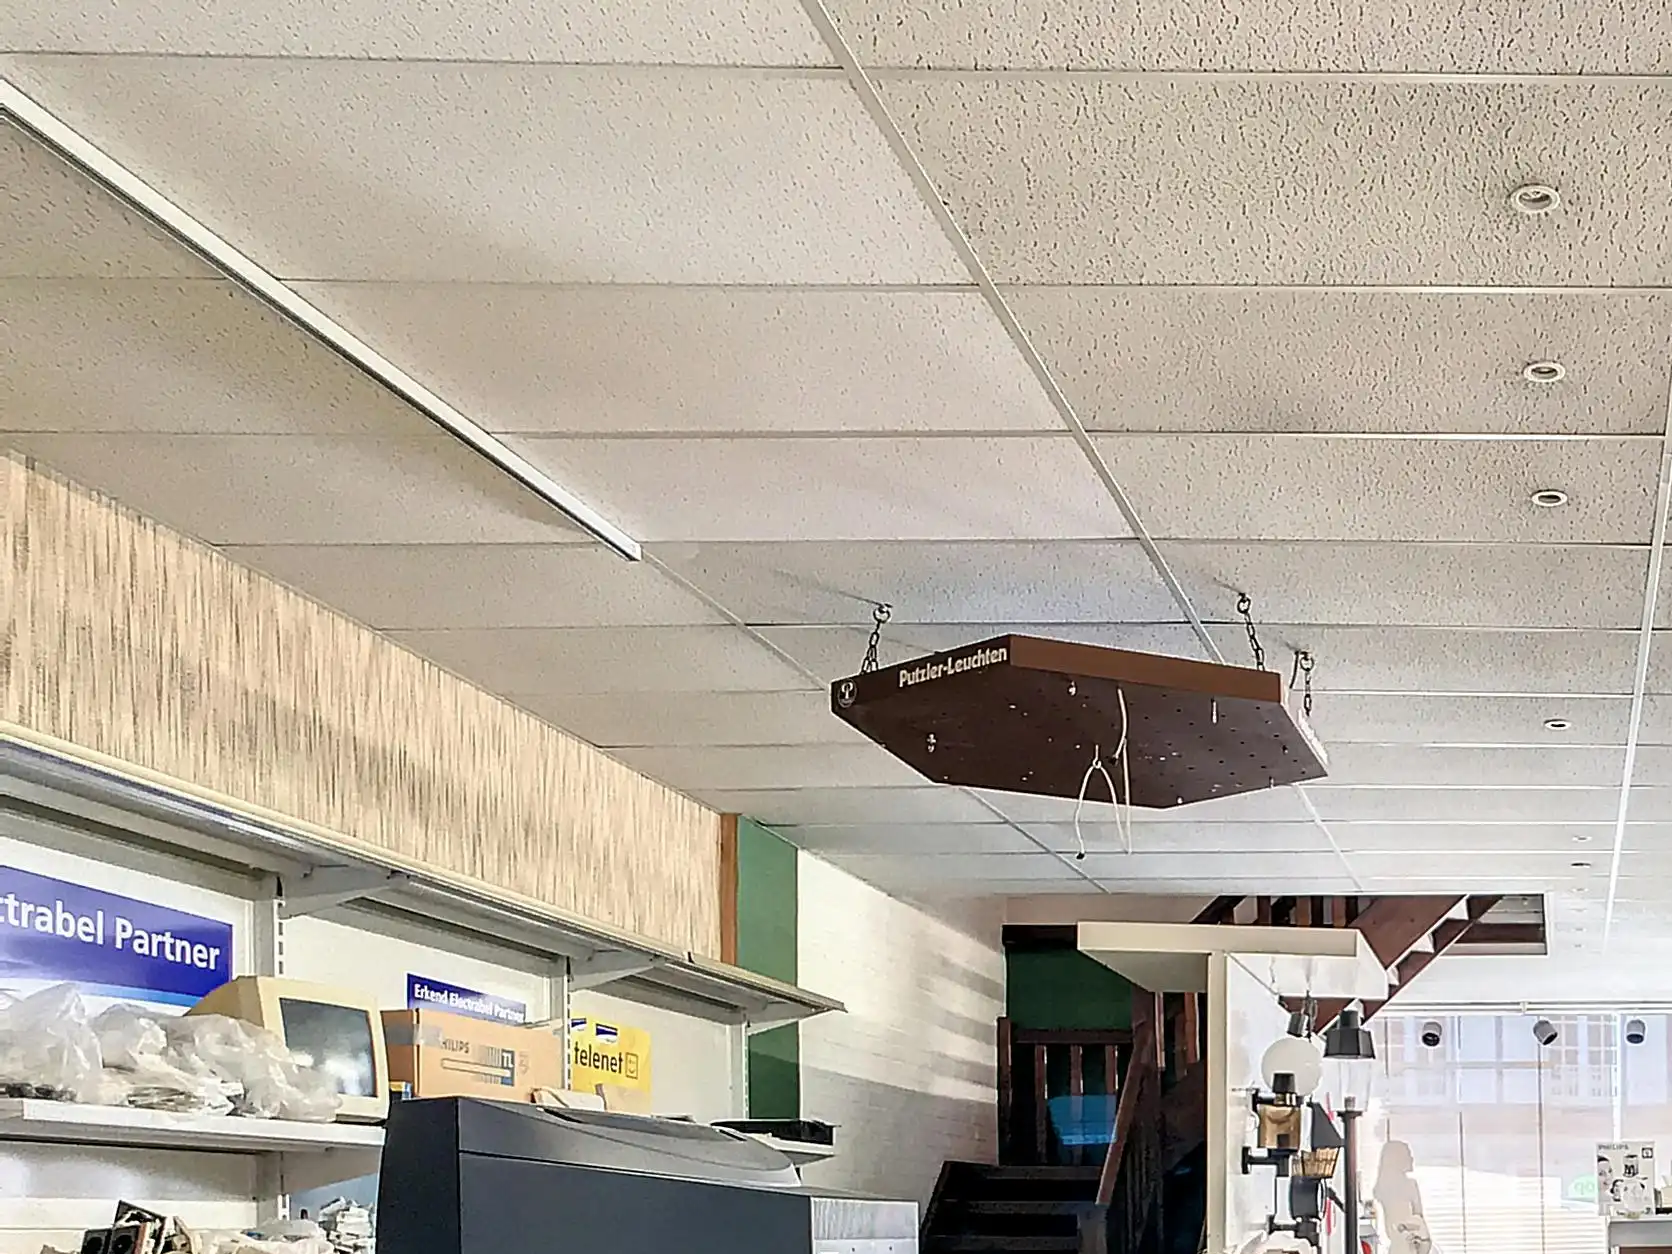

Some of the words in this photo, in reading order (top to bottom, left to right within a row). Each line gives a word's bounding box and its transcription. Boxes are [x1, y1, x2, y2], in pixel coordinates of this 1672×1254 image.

[899, 648, 1008, 687] Putzler-Leuchten
[115, 916, 221, 970] Partner
[414, 983, 448, 1004] Erkend
[439, 1038, 470, 1054] HILIPS
[574, 1041, 624, 1074] telenet
